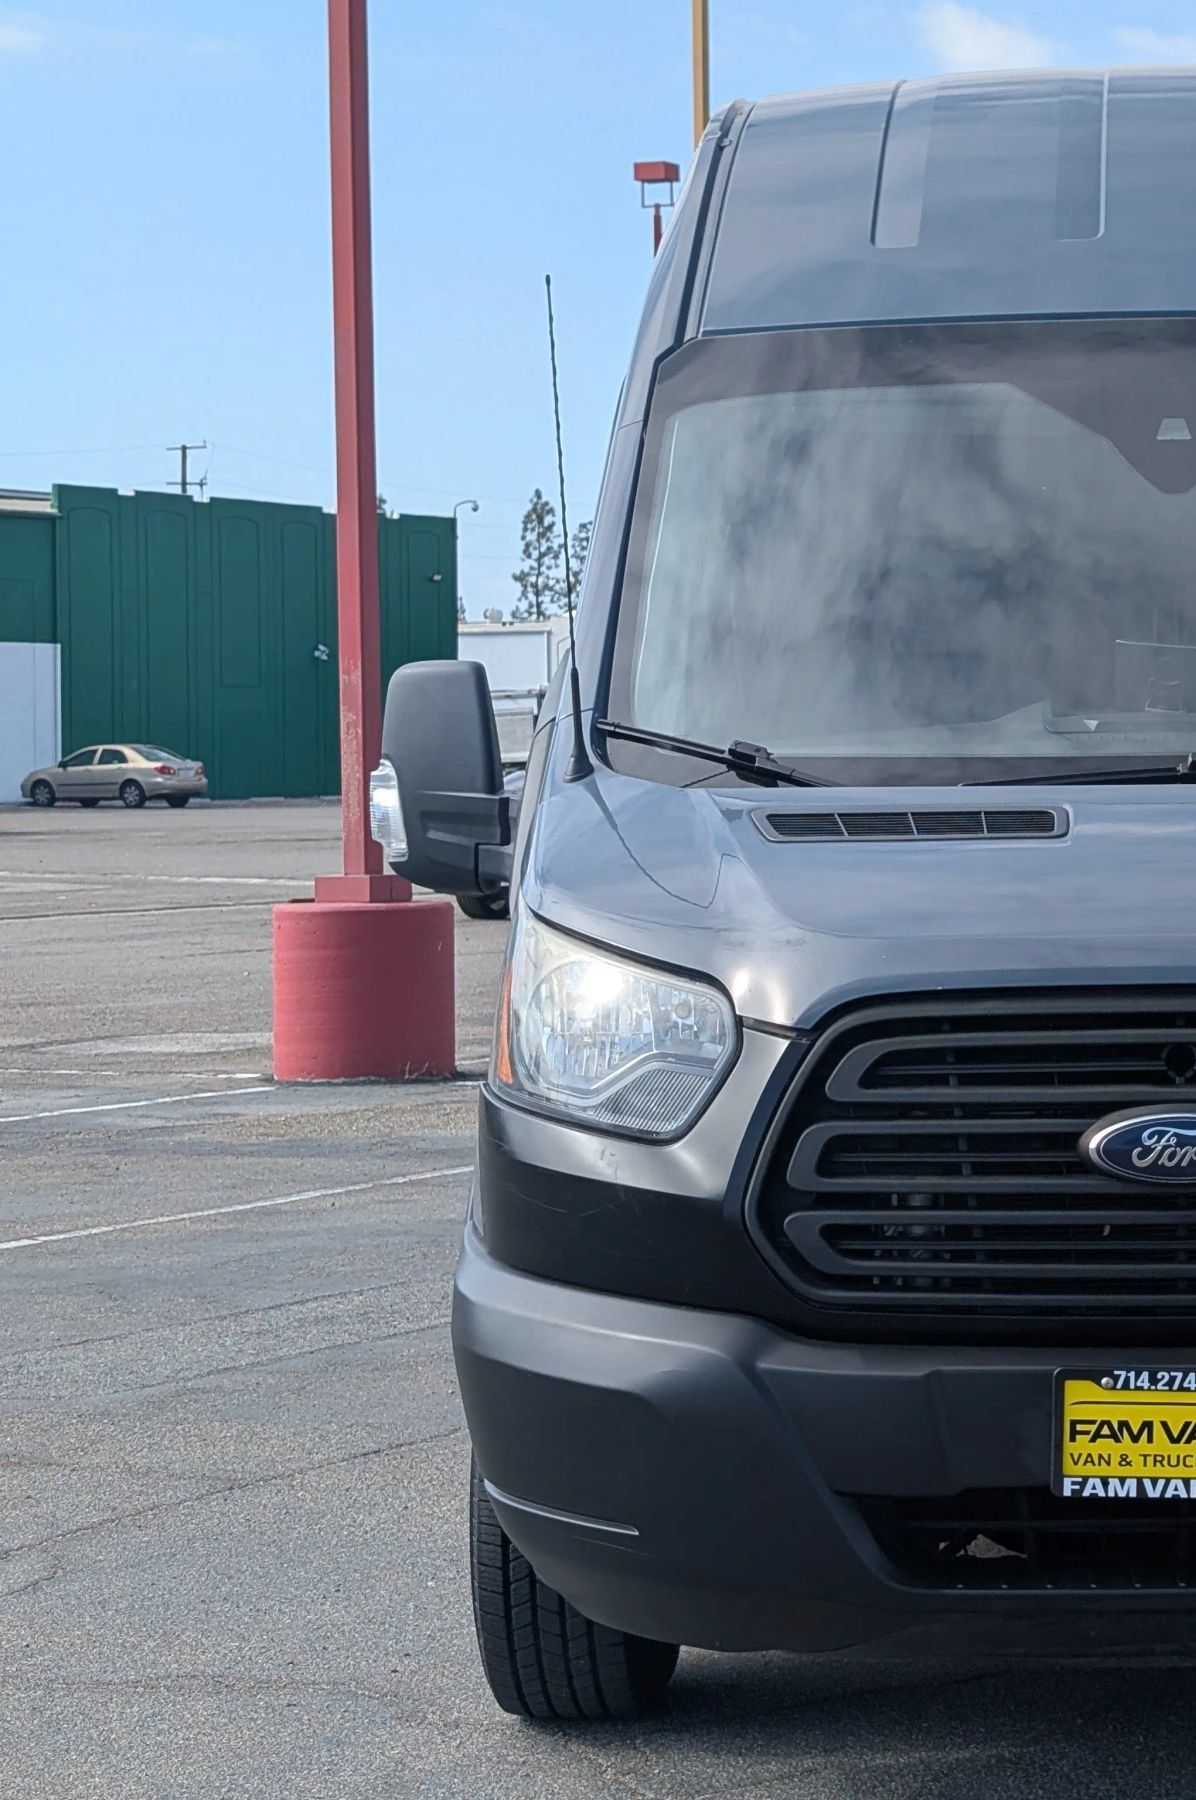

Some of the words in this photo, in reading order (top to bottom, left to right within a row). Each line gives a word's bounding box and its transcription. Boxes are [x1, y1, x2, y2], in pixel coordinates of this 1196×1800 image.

[1068, 1418, 1154, 1444] FAM
[1069, 1452, 1112, 1467] VAN
[1119, 1454, 1133, 1468] &
